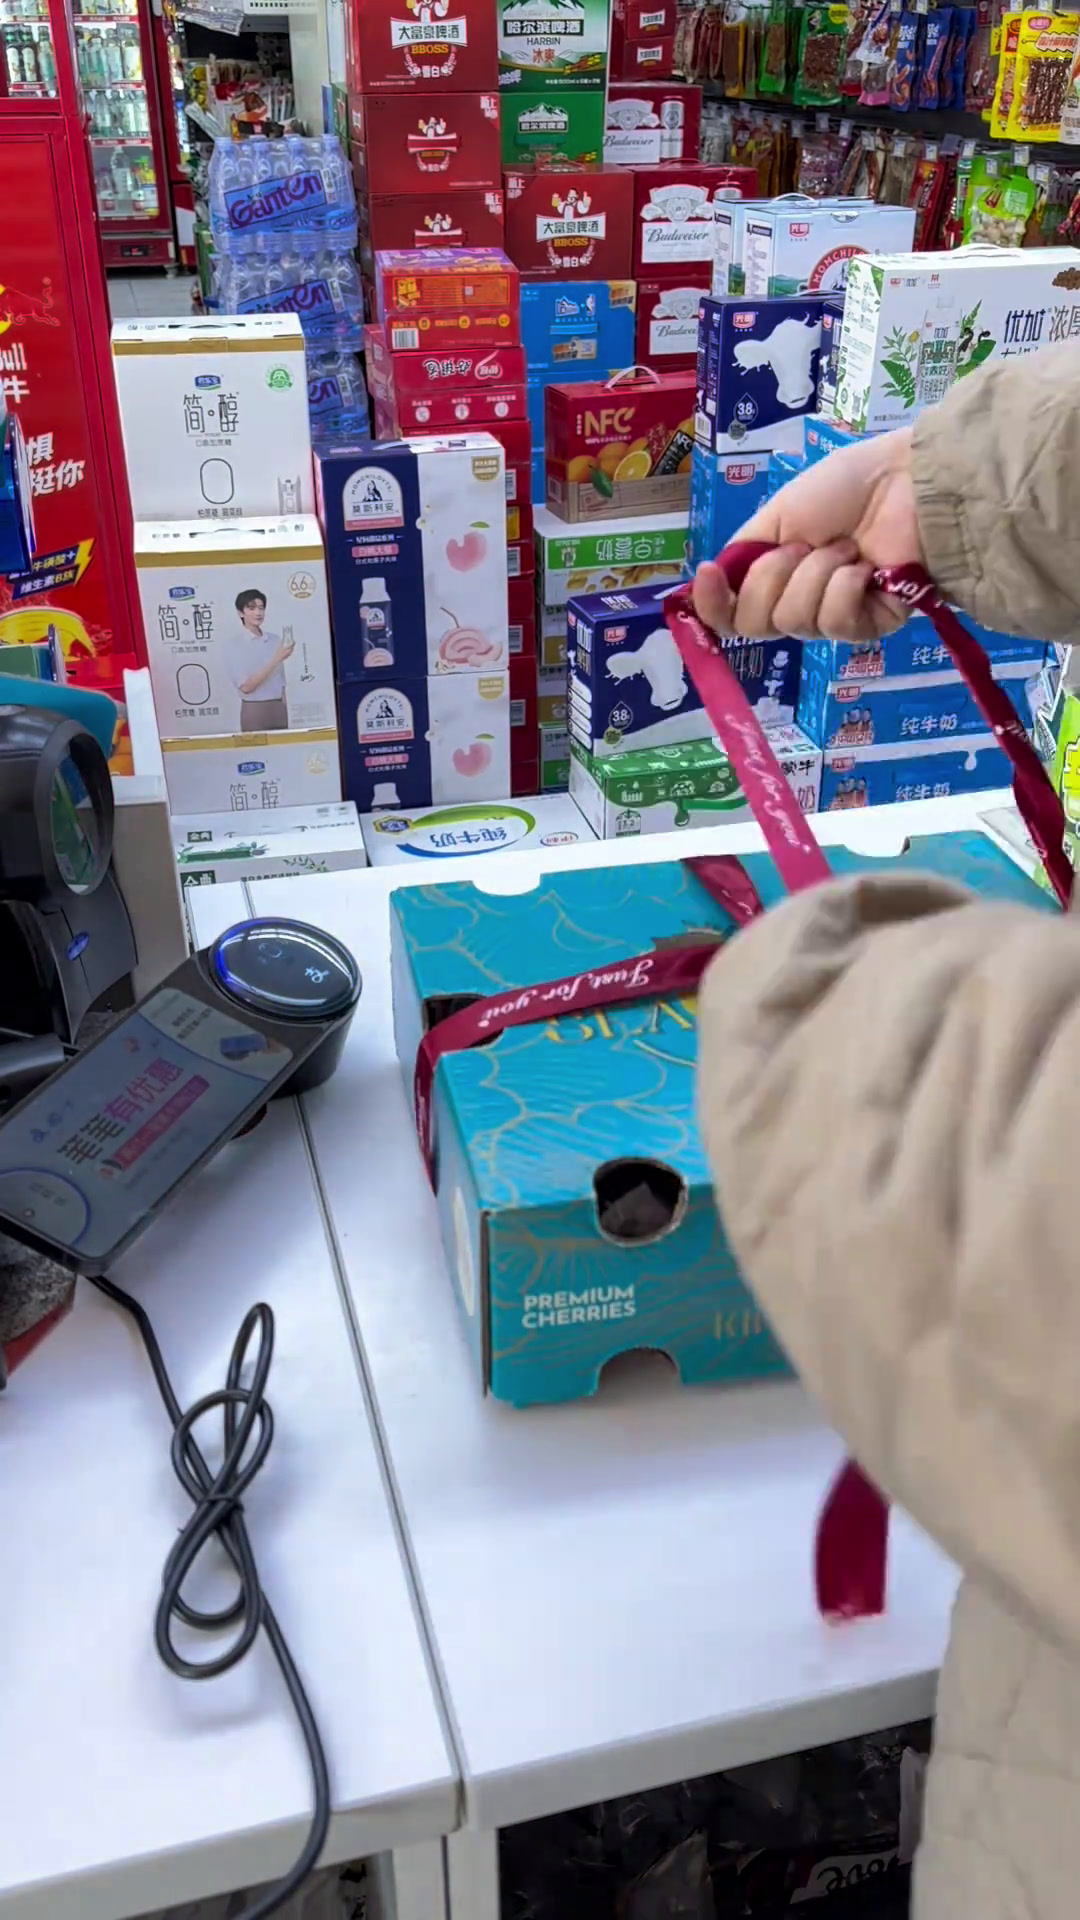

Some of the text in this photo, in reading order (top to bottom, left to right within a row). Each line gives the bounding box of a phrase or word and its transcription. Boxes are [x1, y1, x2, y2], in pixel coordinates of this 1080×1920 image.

[398, 24, 460, 40] 大富豪啤酒
[506, 20, 581, 34] 哈尔滨啤酒
[411, 44, 449, 55] BBOSS
[527, 37, 560, 45] HARBIN
[603, 136, 654, 147] Budweiser
[543, 220, 599, 234] 大富豪啤酒
[646, 228, 710, 243] Budweiser
[554, 238, 588, 248] BBOSS
[734, 313, 755, 325] 光明
[0, 342, 27, 371] ull
[584, 407, 635, 437] NFC
[728, 465, 753, 479] 光明
[596, 536, 652, 561] 早餐奶
[911, 647, 951, 666] 纯牛
[901, 713, 958, 736] 纯牛奶
[430, 827, 508, 848] 纯牛奶
[588, 958, 653, 989] Just
[541, 973, 592, 1001] for
[477, 990, 537, 1028] you
[57, 1058, 184, 1165] 笔笔有优惠
[524, 1283, 635, 1311] PREMIUM
[522, 1300, 636, 1328] CHERRIES
